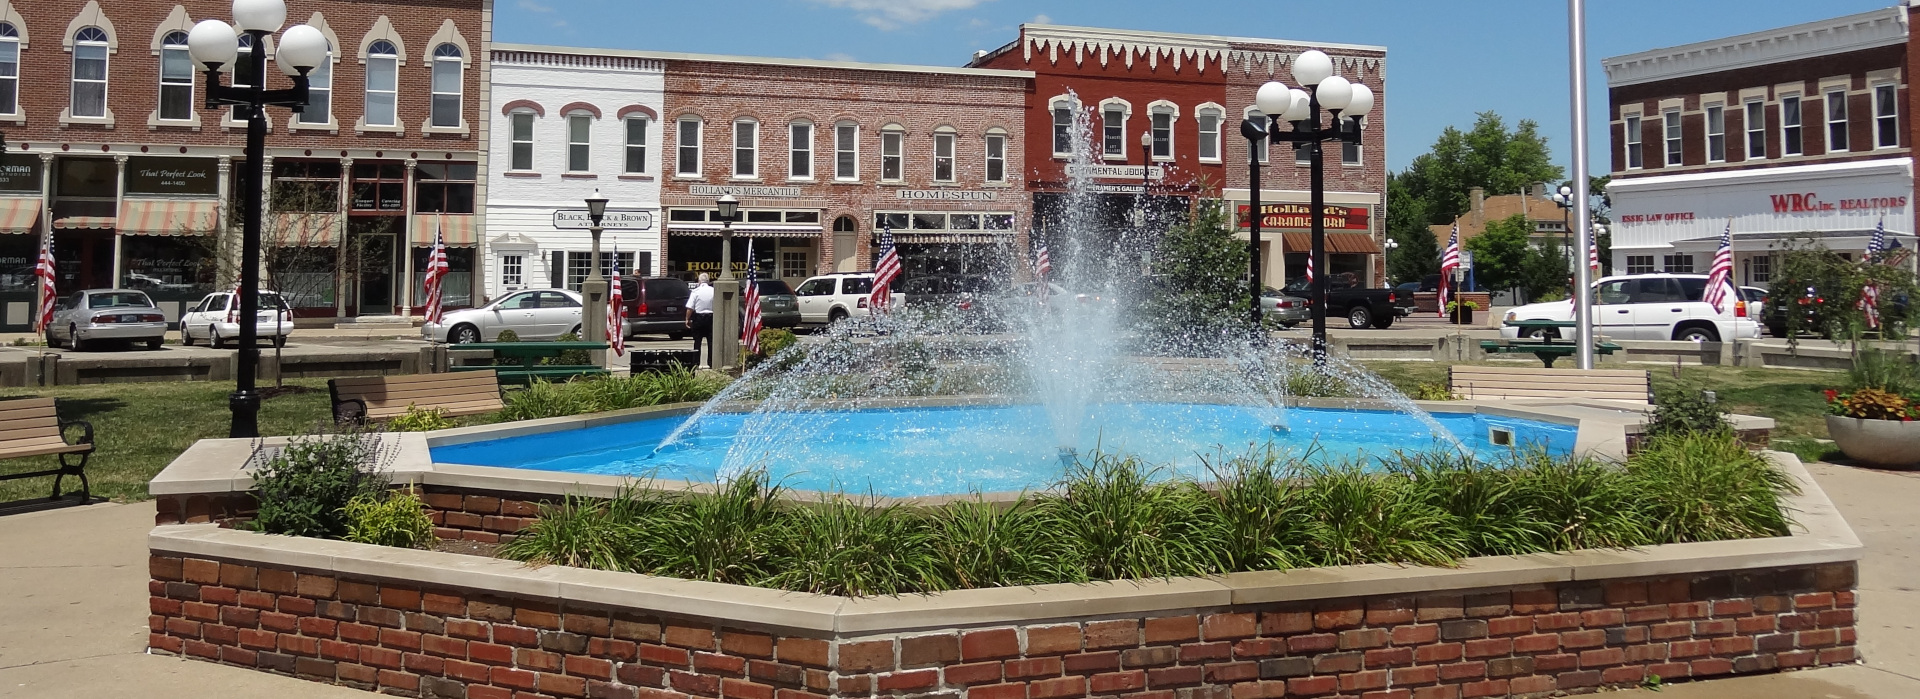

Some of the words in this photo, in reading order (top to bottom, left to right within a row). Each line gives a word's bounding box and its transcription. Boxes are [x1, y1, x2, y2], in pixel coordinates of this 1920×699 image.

[140, 168, 159, 177] That
[160, 169, 187, 179] Perfect
[187, 170, 207, 179] Look
[691, 185, 741, 195] HOLLAND'S
[743, 187, 799, 196] MERCANTILE
[902, 190, 992, 200] HOMESPUN
[1839, 196, 1907, 210] REALTORS
[1260, 205, 1348, 216] Hollad's
[587, 213, 612, 221] BCK
[620, 213, 648, 222] BROWN
[1263, 216, 1346, 228] CARAMEORN
[1621, 214, 1644, 223] ESSIG
[1646, 213, 1662, 222] LAW
[1664, 211, 1695, 221] OFFICE
